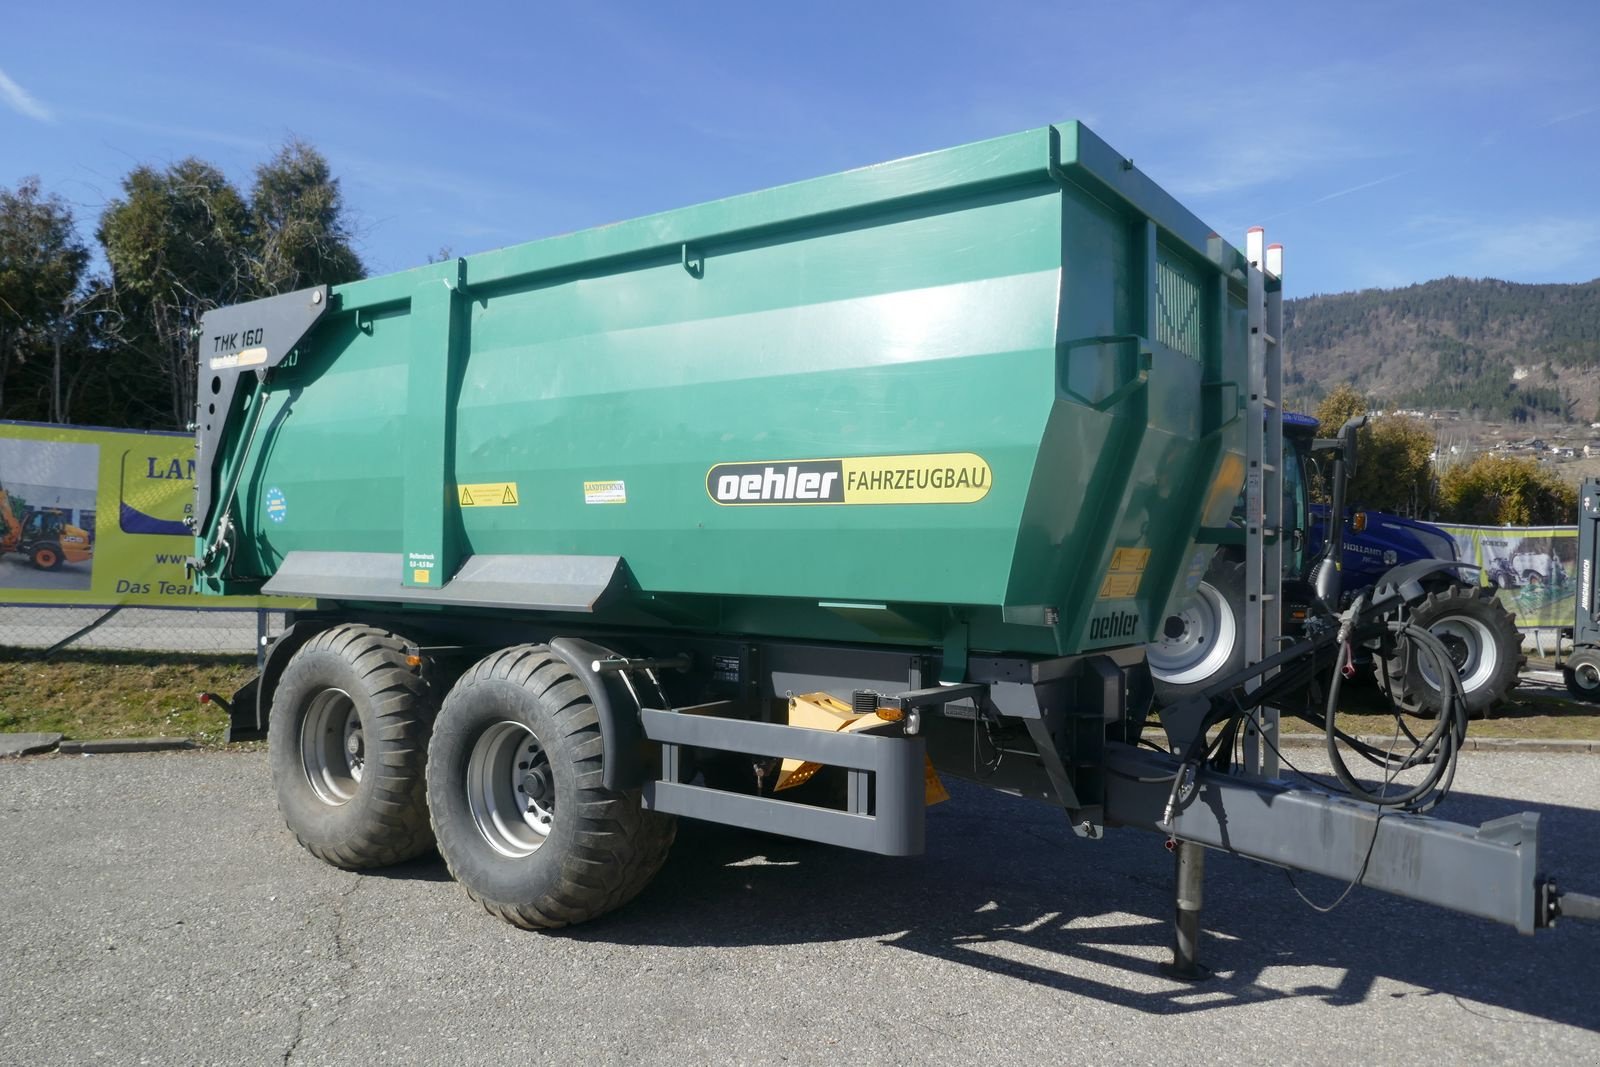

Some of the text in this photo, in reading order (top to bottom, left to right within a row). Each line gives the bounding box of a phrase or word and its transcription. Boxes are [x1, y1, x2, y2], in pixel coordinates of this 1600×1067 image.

[214, 327, 263, 352] TMK 160
[717, 466, 986, 500] oehler FAHRZEUGBAU
[1343, 542, 1382, 556] HOLLAND
[116, 579, 151, 594] Das
[1089, 610, 1139, 640] oehler
